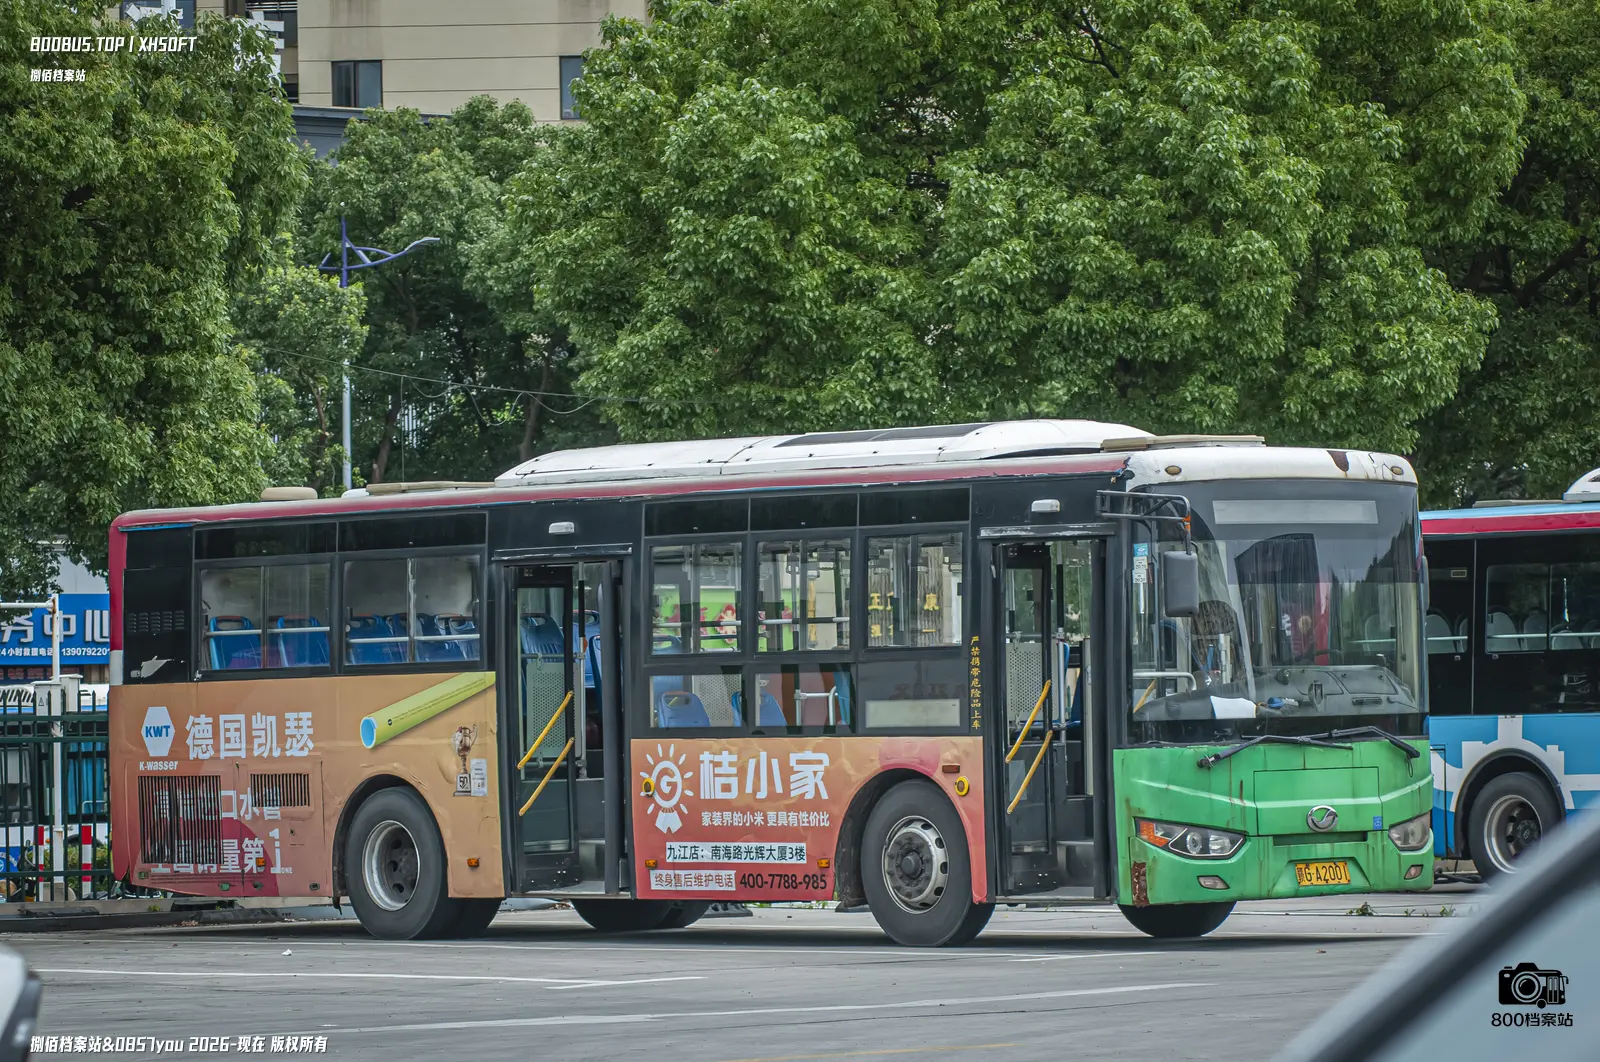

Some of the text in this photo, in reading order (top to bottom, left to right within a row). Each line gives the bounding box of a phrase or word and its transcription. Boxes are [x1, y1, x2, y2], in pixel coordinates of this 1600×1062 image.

[0, 647, 110, 656] 4小时救援电话 139079220
[970, 635, 982, 730] 严禁携带危险品上车
[145, 725, 171, 738] KWT
[185, 711, 315, 760] 德国凯瑟
[139, 760, 179, 771] K-wasser
[699, 750, 830, 800] 桔小家
[701, 811, 830, 827] 家装界的小米 更具有性价比
[654, 872, 828, 890] 终身售后维护电话 400-7788-985
